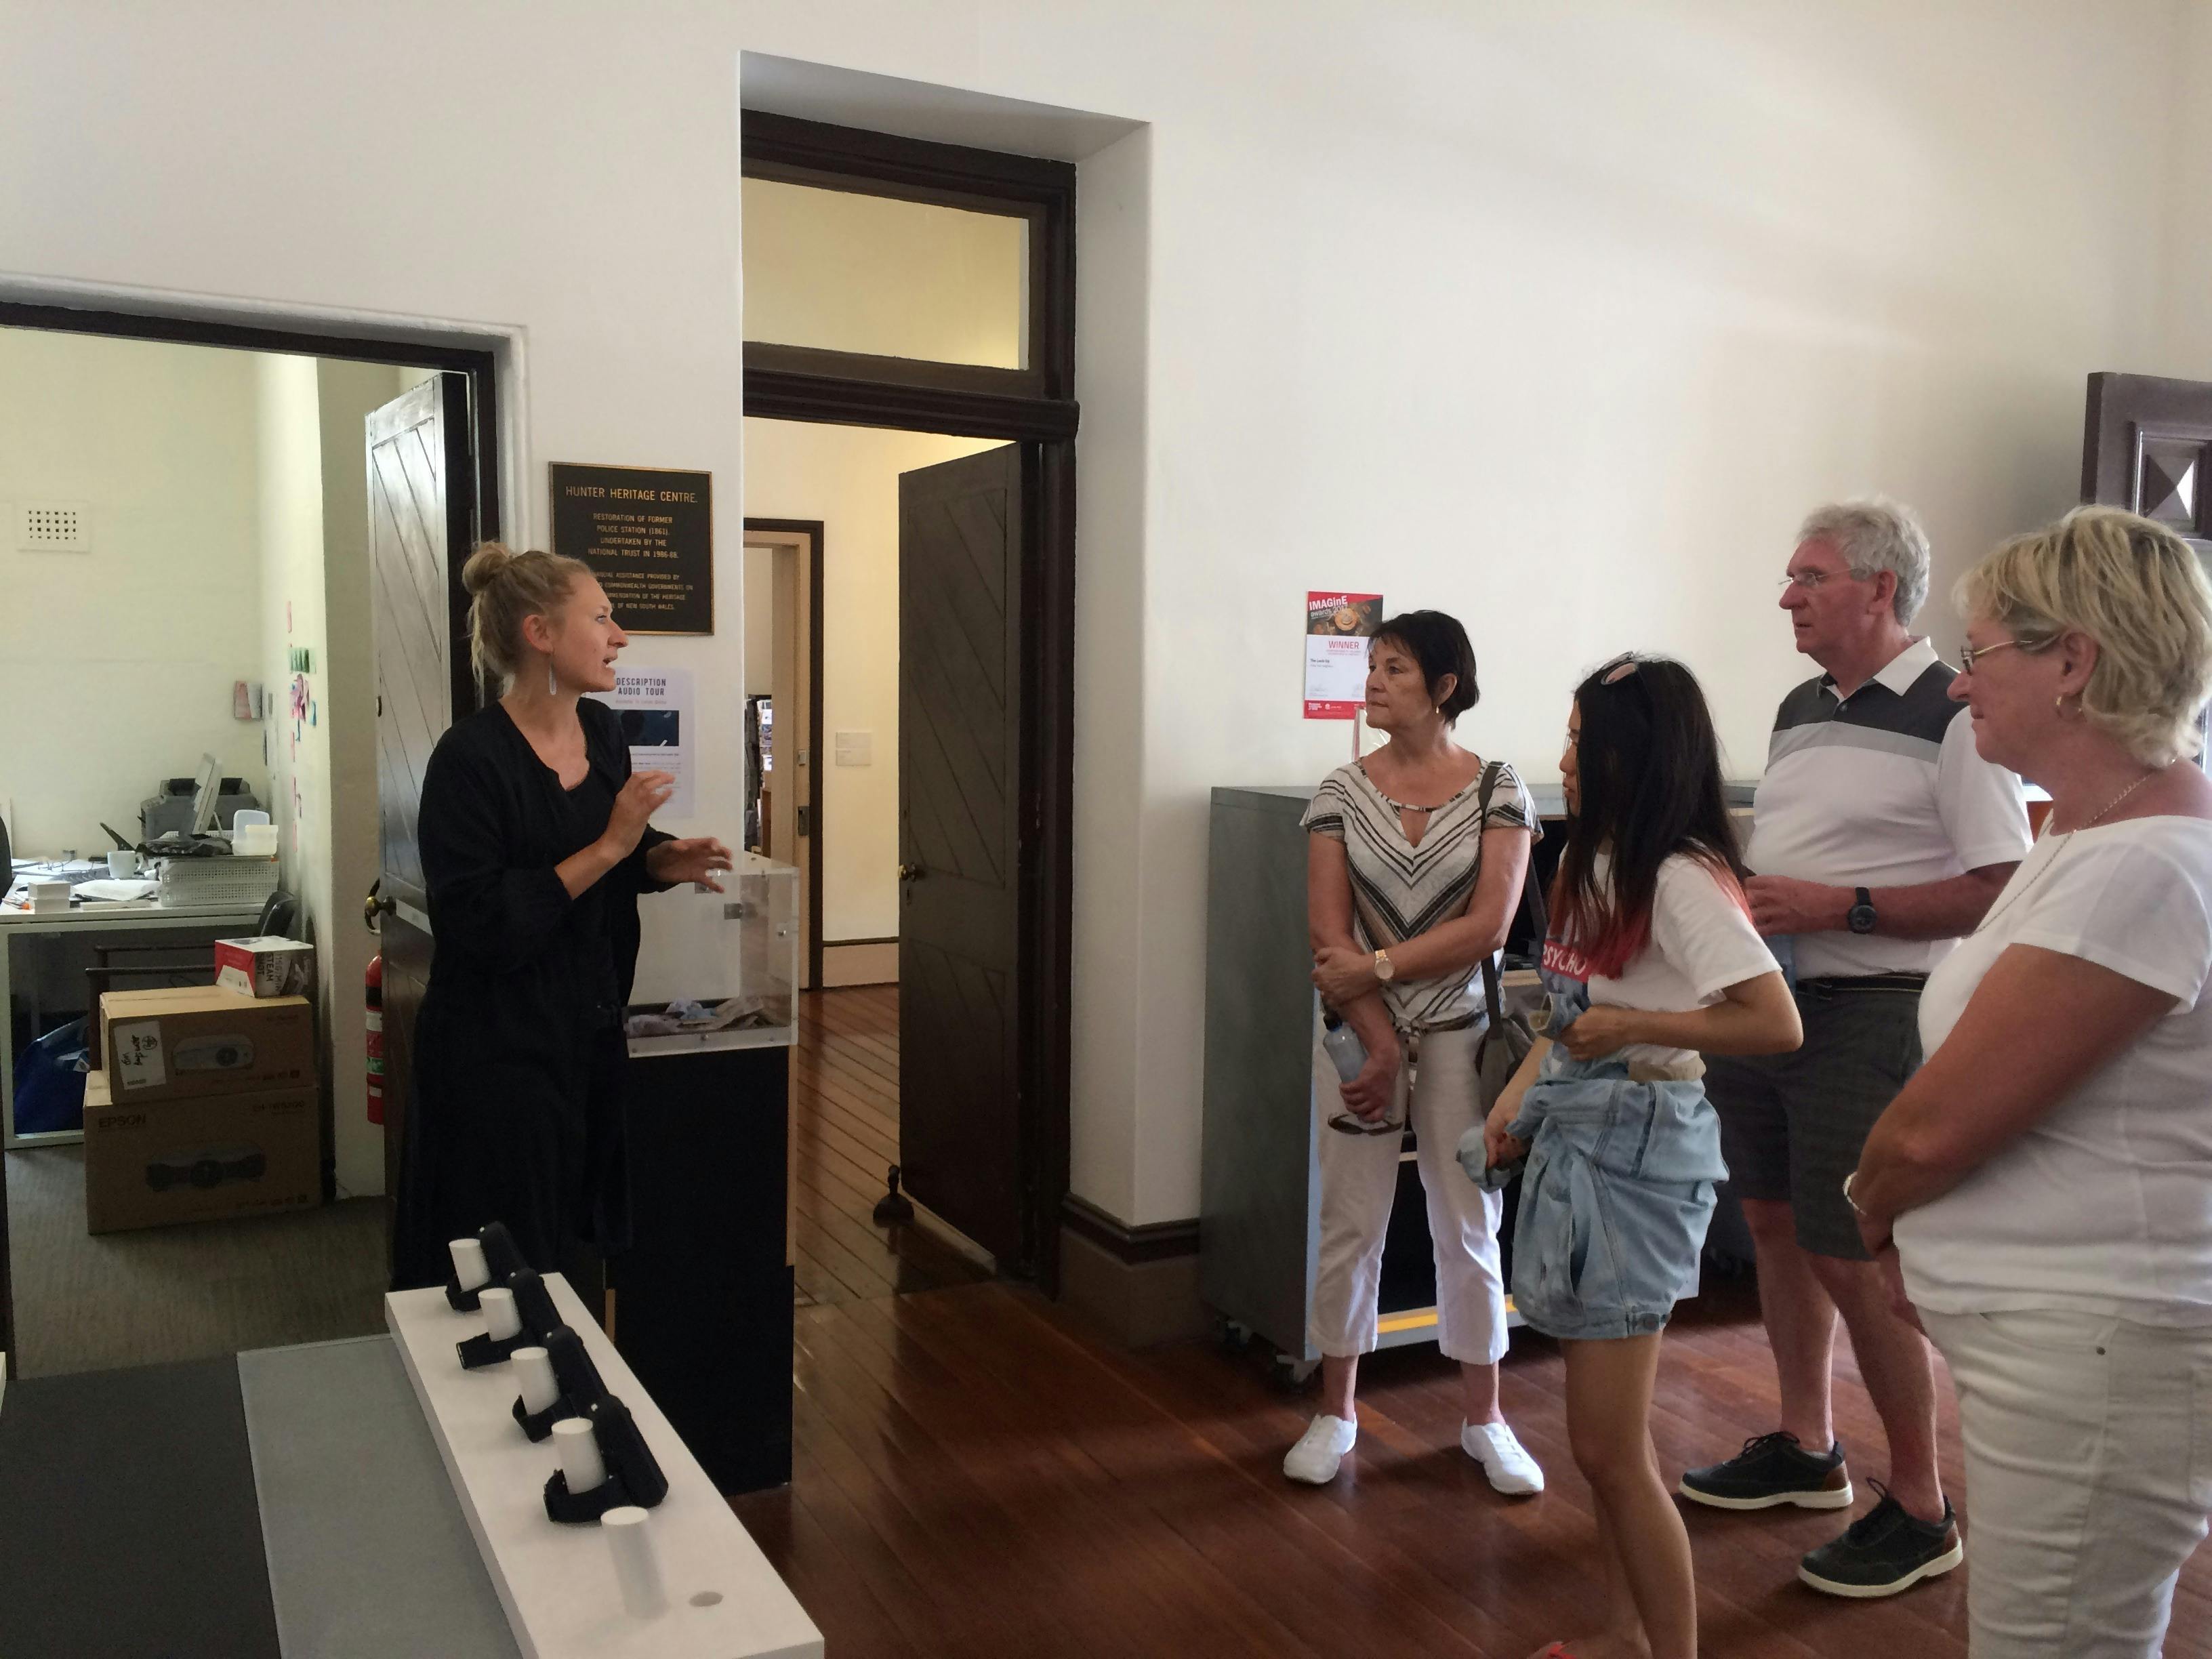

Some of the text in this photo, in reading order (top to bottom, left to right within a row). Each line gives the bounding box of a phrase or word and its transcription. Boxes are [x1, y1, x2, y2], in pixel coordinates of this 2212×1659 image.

[566, 486, 605, 498] HUNTER
[610, 488, 655, 501] HERITAGE
[593, 513, 672, 524] RESTORATION OF FORMER
[597, 525, 618, 533] POLICE
[621, 526, 646, 534] STATION
[600, 537, 641, 546] UNDERTAKEN
[588, 548, 617, 556] NATIONAL
[621, 549, 640, 557] TRUST
[1309, 595, 1348, 611] IMAGinE
[1328, 641, 1359, 649] WINNER
[616, 677, 666, 687] DESCRIPTION
[618, 687, 665, 696] AUDIO TOUR
[98, 1113, 146, 1128] EPSON
